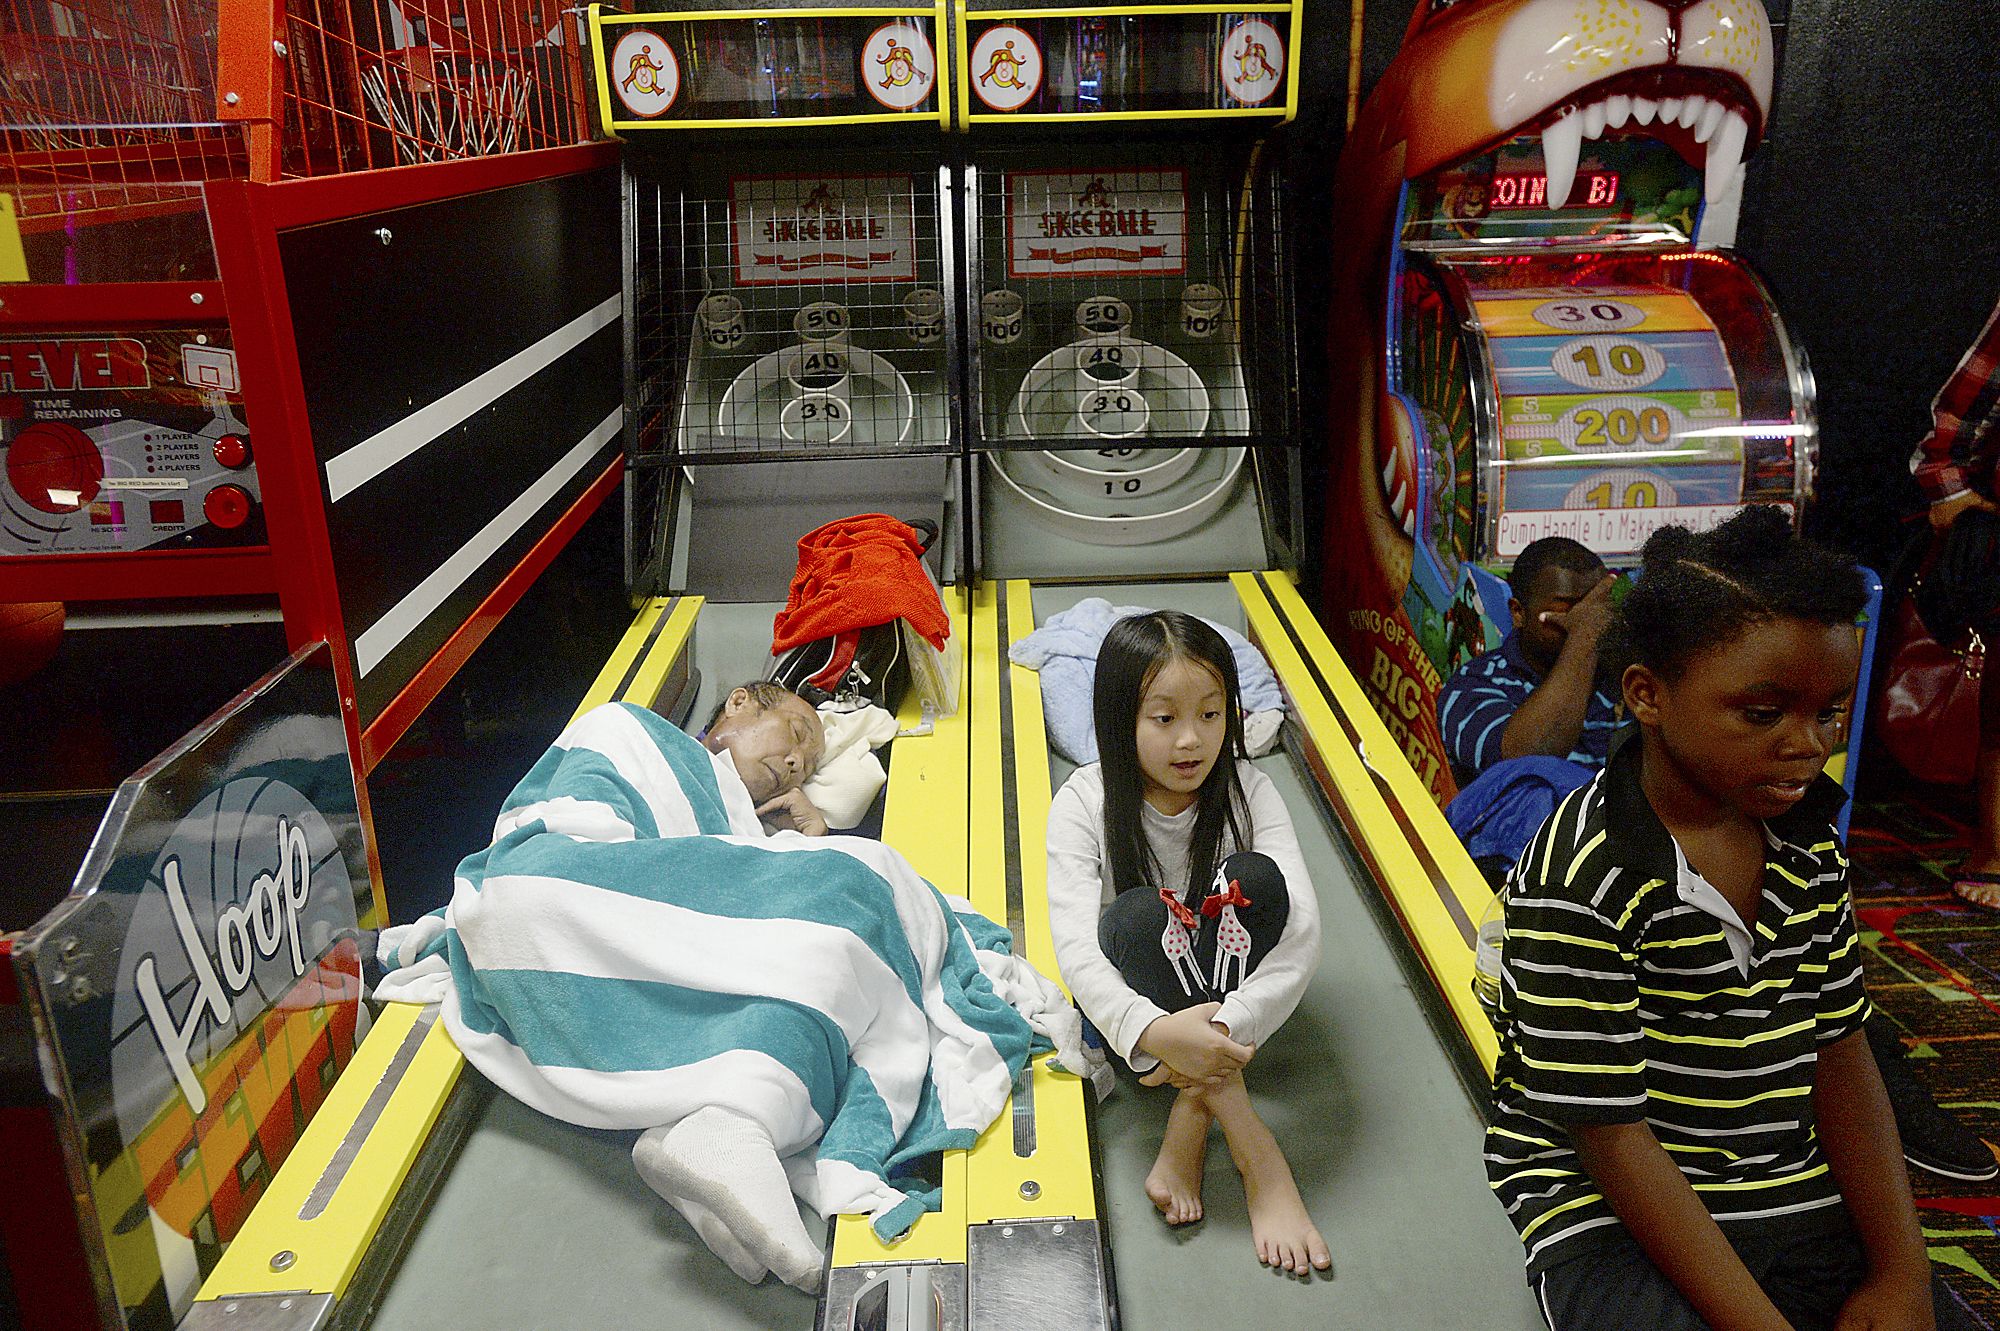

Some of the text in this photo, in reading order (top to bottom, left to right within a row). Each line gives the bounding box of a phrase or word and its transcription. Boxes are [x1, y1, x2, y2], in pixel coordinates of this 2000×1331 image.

[807, 309, 841, 328] 50
[1086, 305, 1119, 323] 50
[1553, 304, 1622, 322] 30
[804, 352, 839, 370] 40
[1089, 348, 1123, 363] 40
[1572, 344, 1646, 377] 10
[34, 399, 72, 409] TIME
[800, 402, 841, 420] 30
[1093, 396, 1132, 414] 30
[34, 408, 122, 420] REMAINING
[1574, 406, 1670, 446] 200
[162, 433, 193, 441] PLAYER
[163, 443, 199, 451] PLAYERS
[164, 453, 200, 461] PLAYERS
[165, 464, 201, 472] PLAYERS
[1105, 478, 1142, 495] 10
[1586, 481, 1657, 509] 10
[1500, 516, 1537, 545] Pump
[1544, 513, 1590, 542] Handle
[1597, 512, 1614, 541] To
[1384, 616, 1406, 646] OF
[1369, 645, 1422, 721] BIG
[135, 817, 312, 1114] Hoop
